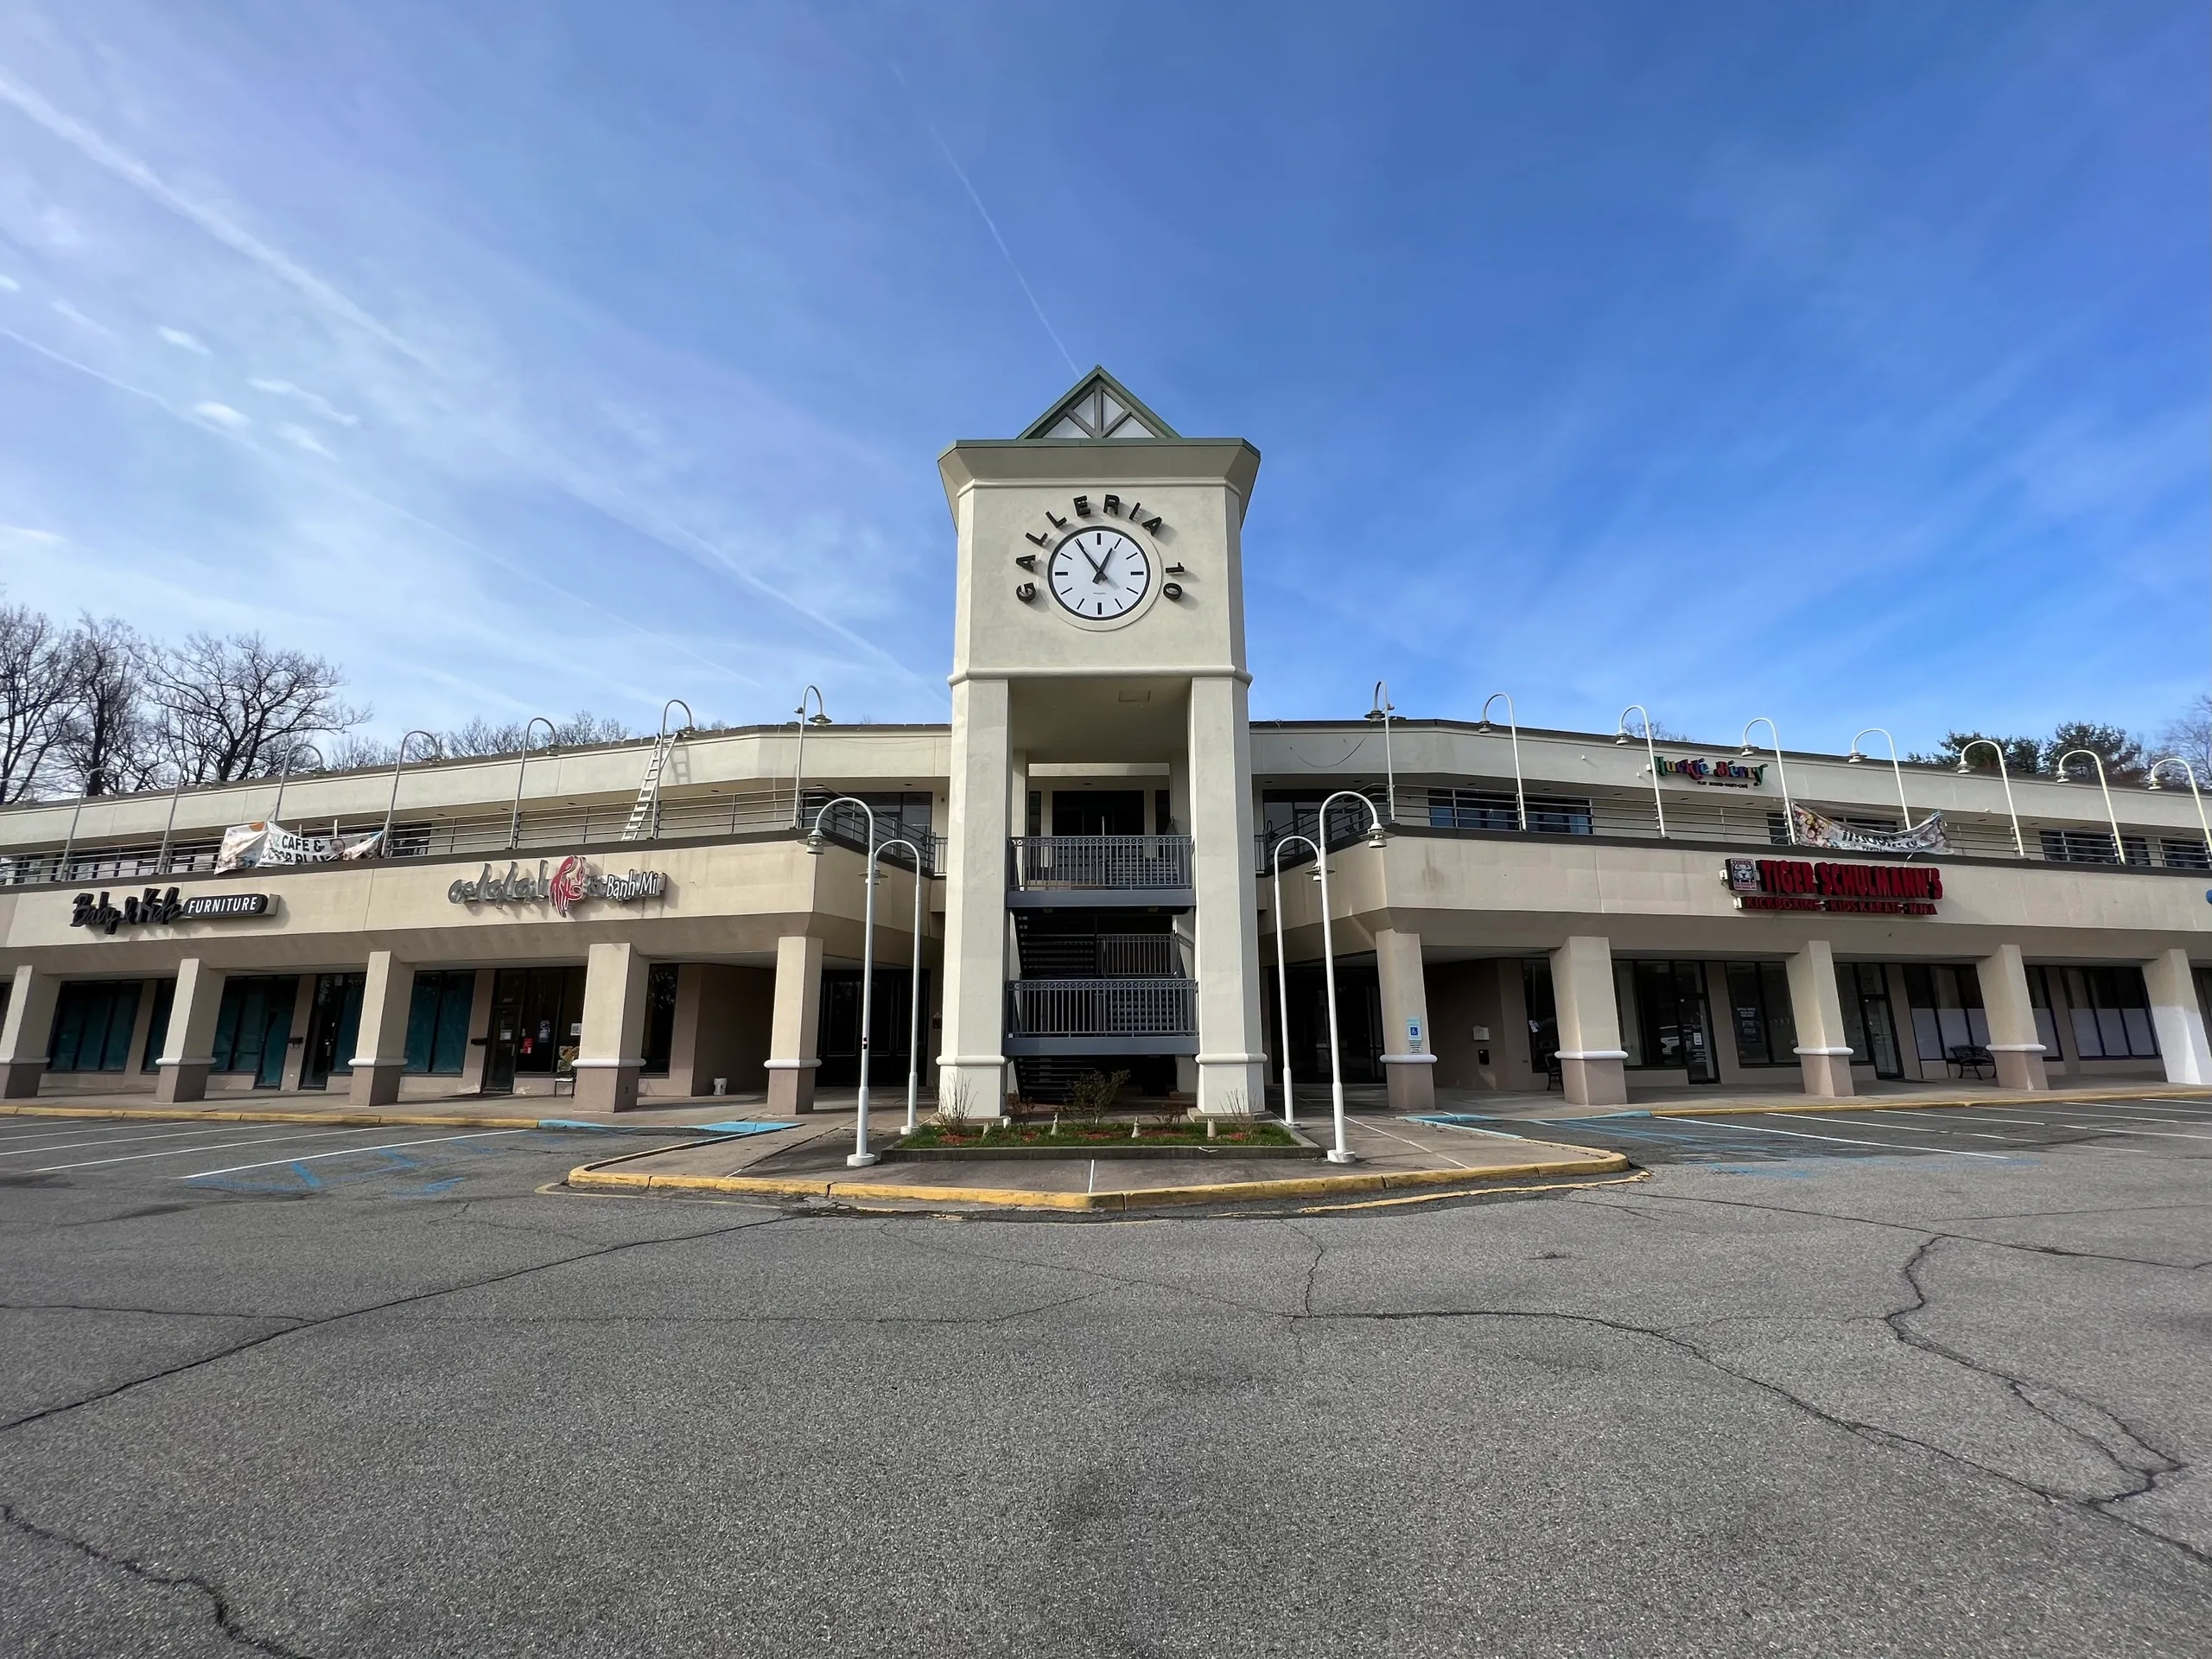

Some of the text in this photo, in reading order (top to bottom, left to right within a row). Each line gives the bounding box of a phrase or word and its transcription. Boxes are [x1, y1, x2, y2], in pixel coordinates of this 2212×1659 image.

[1015, 493, 1185, 602] GALLERIA 10
[1713, 759, 1769, 786] Berry
[282, 835, 310, 852] CAFE
[313, 839, 326, 853] &
[606, 869, 636, 899] Banh
[639, 870, 658, 896] Mi
[1757, 860, 1943, 899] TIGER SCHULMANN'S
[70, 891, 122, 935] Baby
[188, 895, 258, 914] FURNITURE
[1745, 896, 1822, 912] KICKBOXING
[1829, 899, 1858, 913] KIDS
[1859, 901, 1902, 915] KARATE
